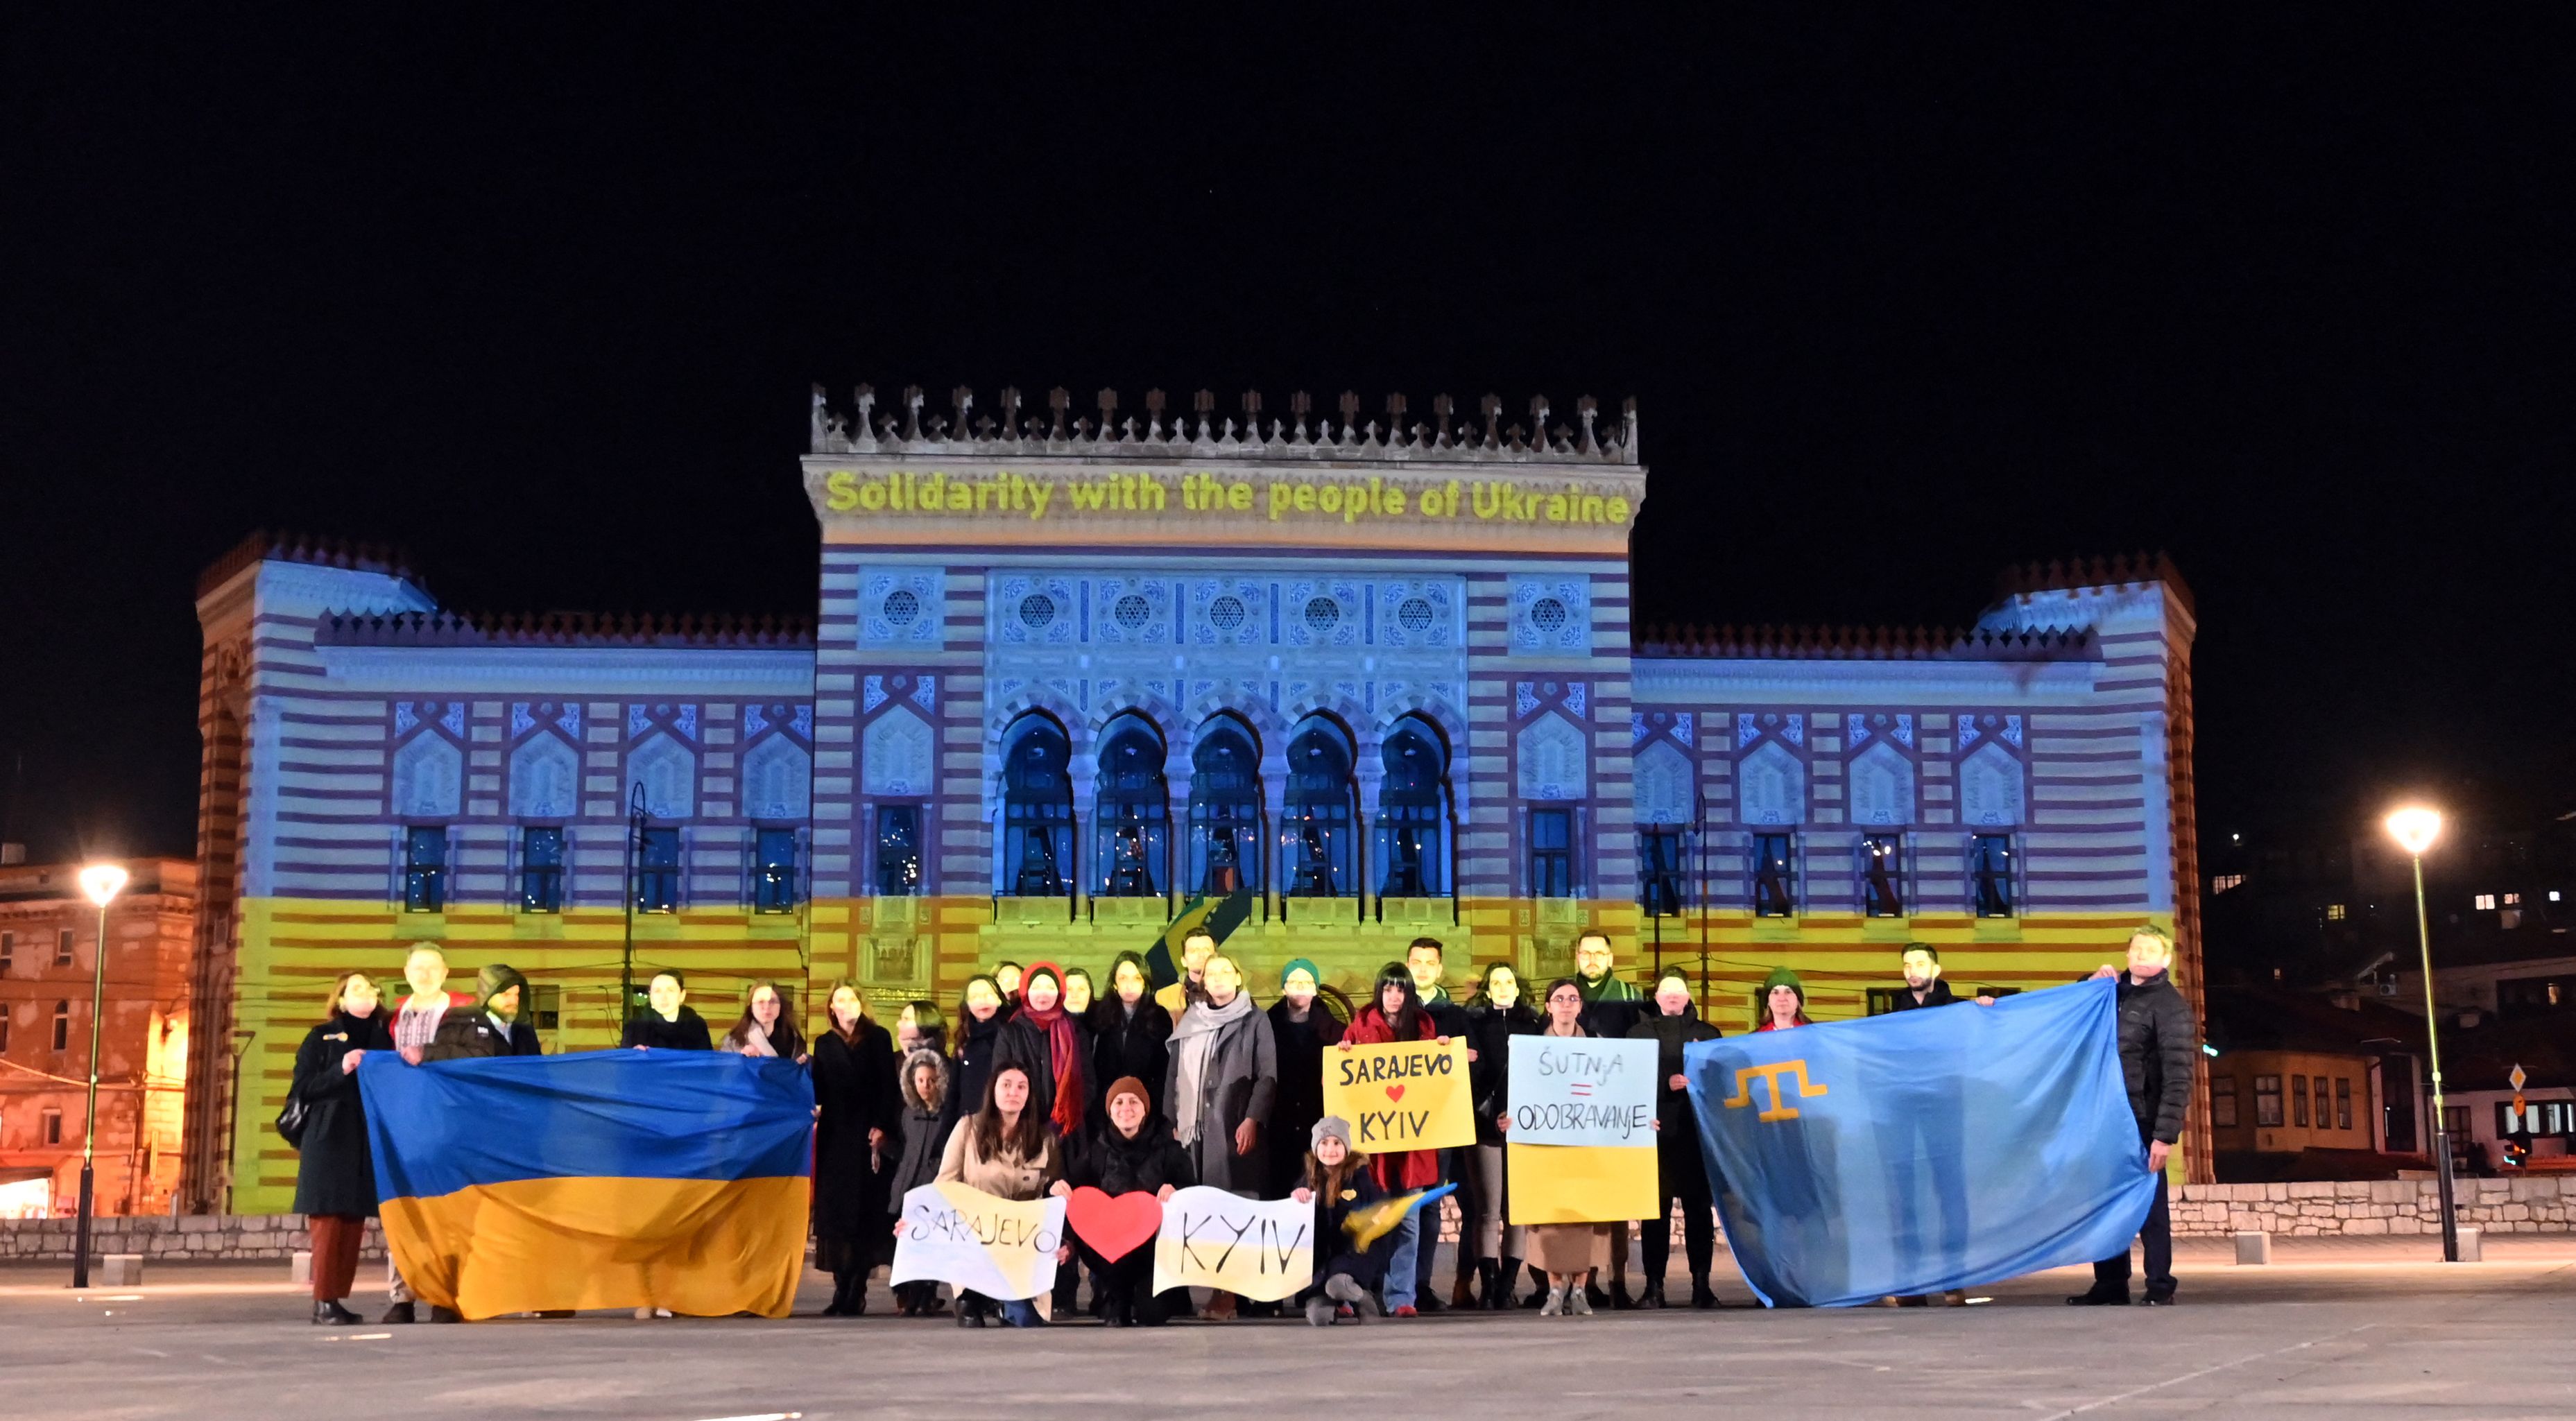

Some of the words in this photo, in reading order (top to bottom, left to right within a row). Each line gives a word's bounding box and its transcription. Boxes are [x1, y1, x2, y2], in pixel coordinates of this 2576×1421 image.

[827, 472, 1053, 520] Solidarity
[1069, 473, 1165, 510] with
[1182, 473, 1254, 510] the
[1269, 478, 1407, 523] people
[1420, 480, 1458, 517] of
[1472, 481, 1630, 523] Ukraine
[1339, 1053, 1452, 1086] SARAJEVO
[1360, 1110, 1429, 1144] KYIV
[911, 1205, 1057, 1253] SARAJEVO
[1180, 1212, 1306, 1275] KYIV
